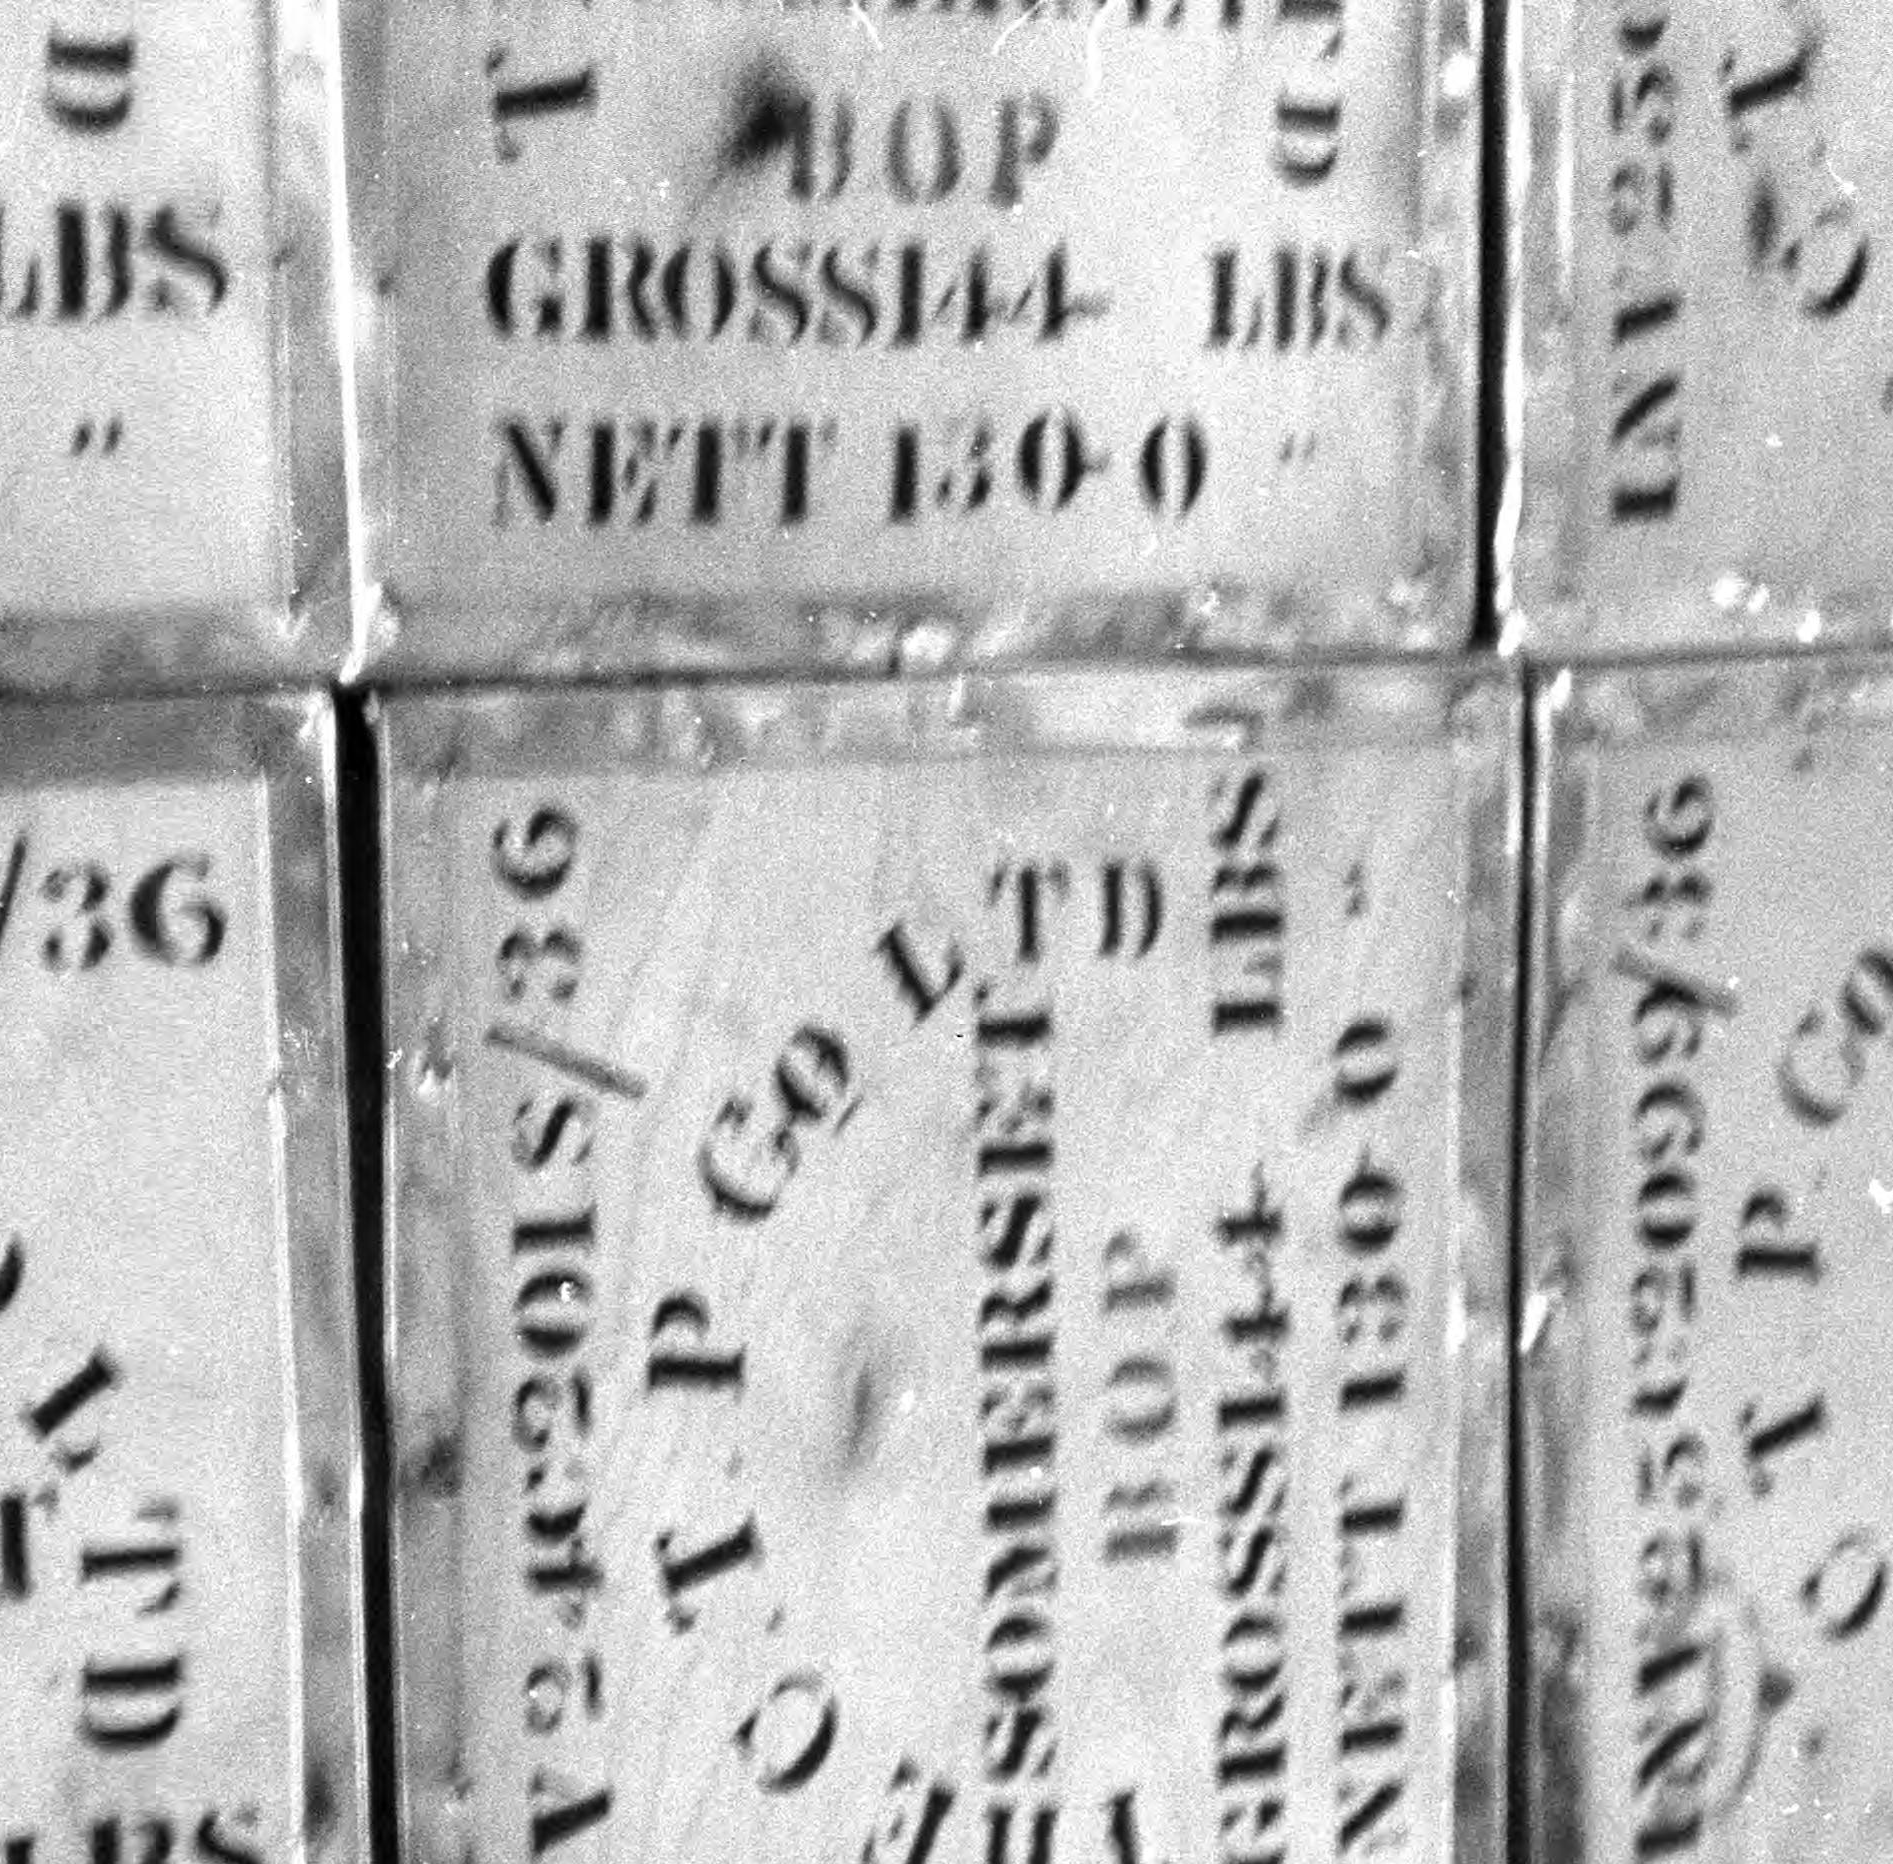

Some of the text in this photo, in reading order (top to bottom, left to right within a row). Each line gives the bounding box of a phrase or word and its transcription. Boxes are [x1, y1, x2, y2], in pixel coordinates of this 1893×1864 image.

[1205, 245, 1392, 351] LBS
[495, 412, 836, 529] NETT
[1209, 771, 1285, 1033] LBS
[974, 977, 1055, 1781] SOMERSET
[1102, 1232, 1179, 1563] BOP
[1337, 1467, 1406, 1858] NETT
